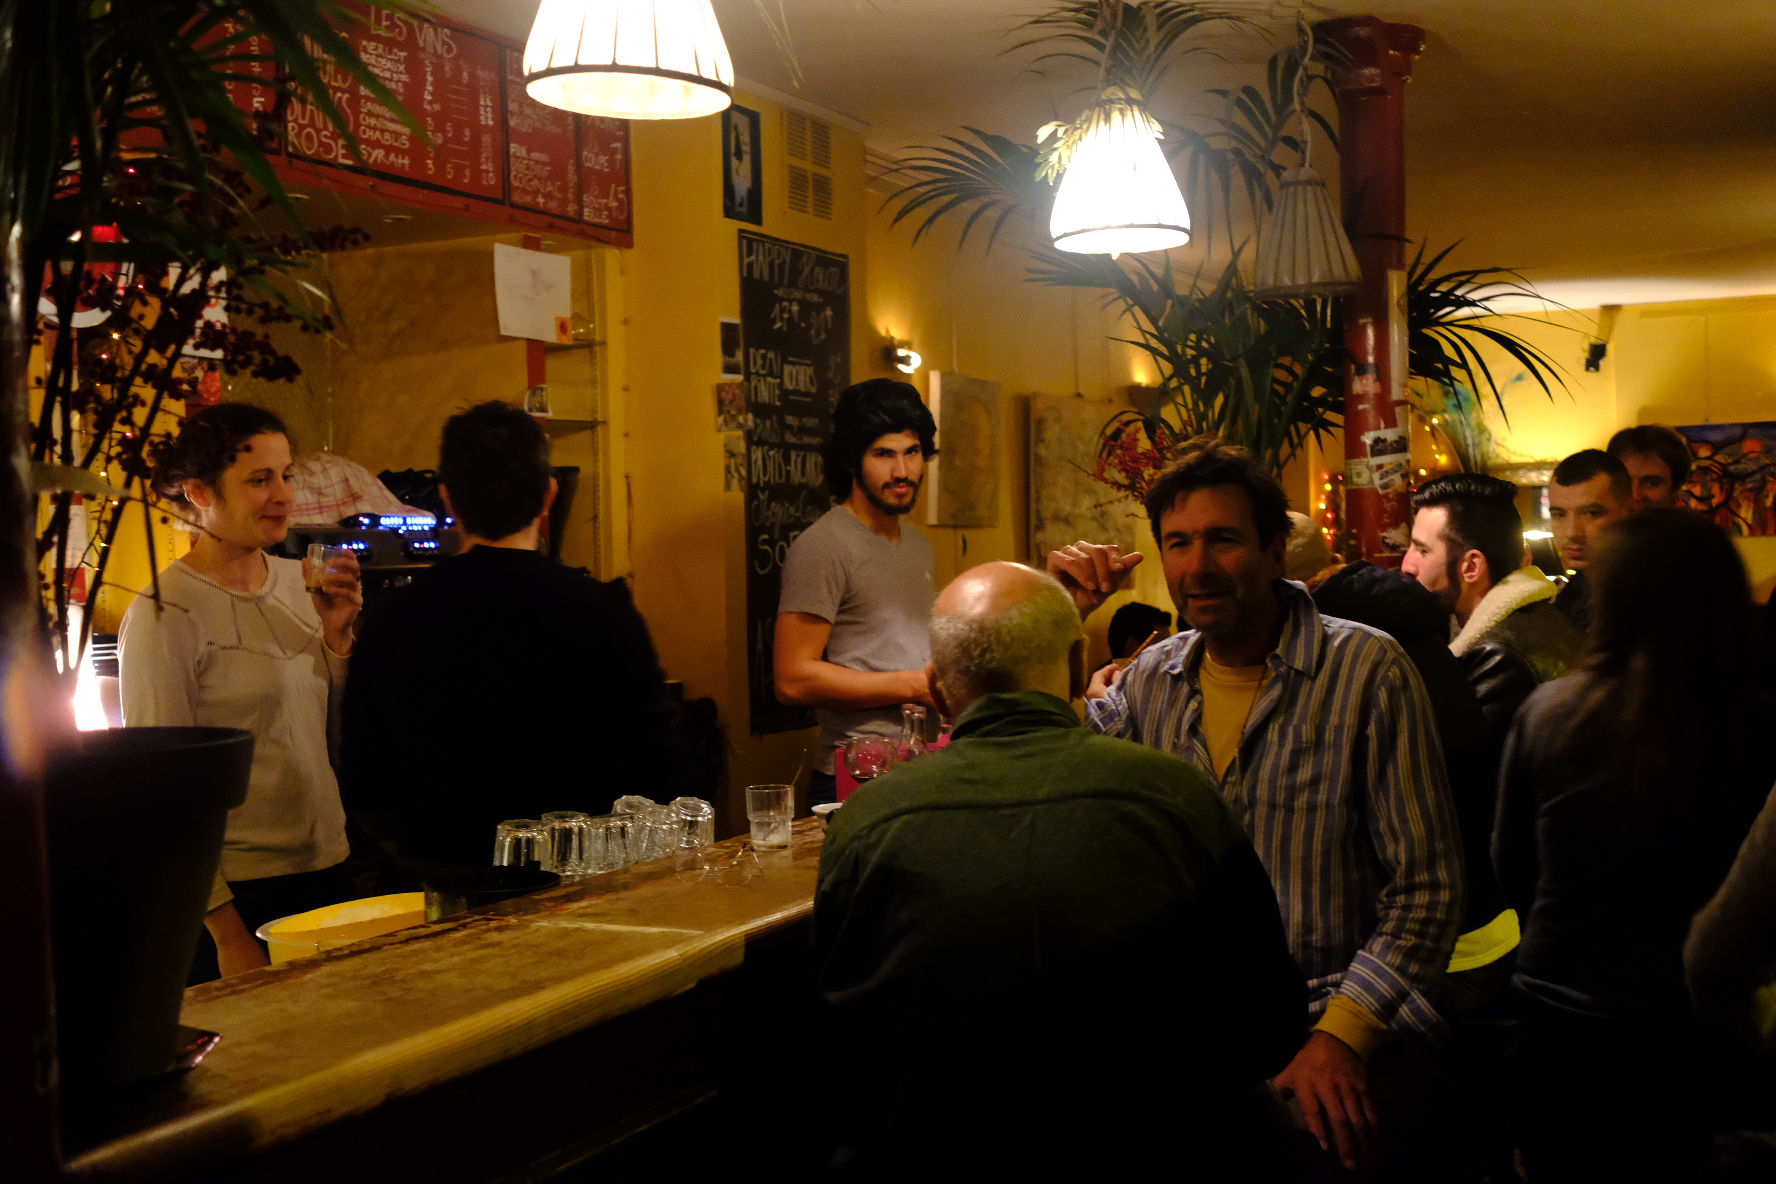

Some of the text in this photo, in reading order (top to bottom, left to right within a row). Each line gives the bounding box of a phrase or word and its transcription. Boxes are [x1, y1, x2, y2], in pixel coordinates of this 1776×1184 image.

[370, 6, 457, 58] LES VINS
[360, 40, 407, 58] MERLOT
[360, 52, 406, 74] BORDEAUX
[360, 126, 410, 149] CHABLIS
[360, 145, 410, 171] SYRAH
[511, 170, 564, 198] COGNAC
[742, 238, 792, 286] HAPPY
[751, 375, 782, 407] PINTE
